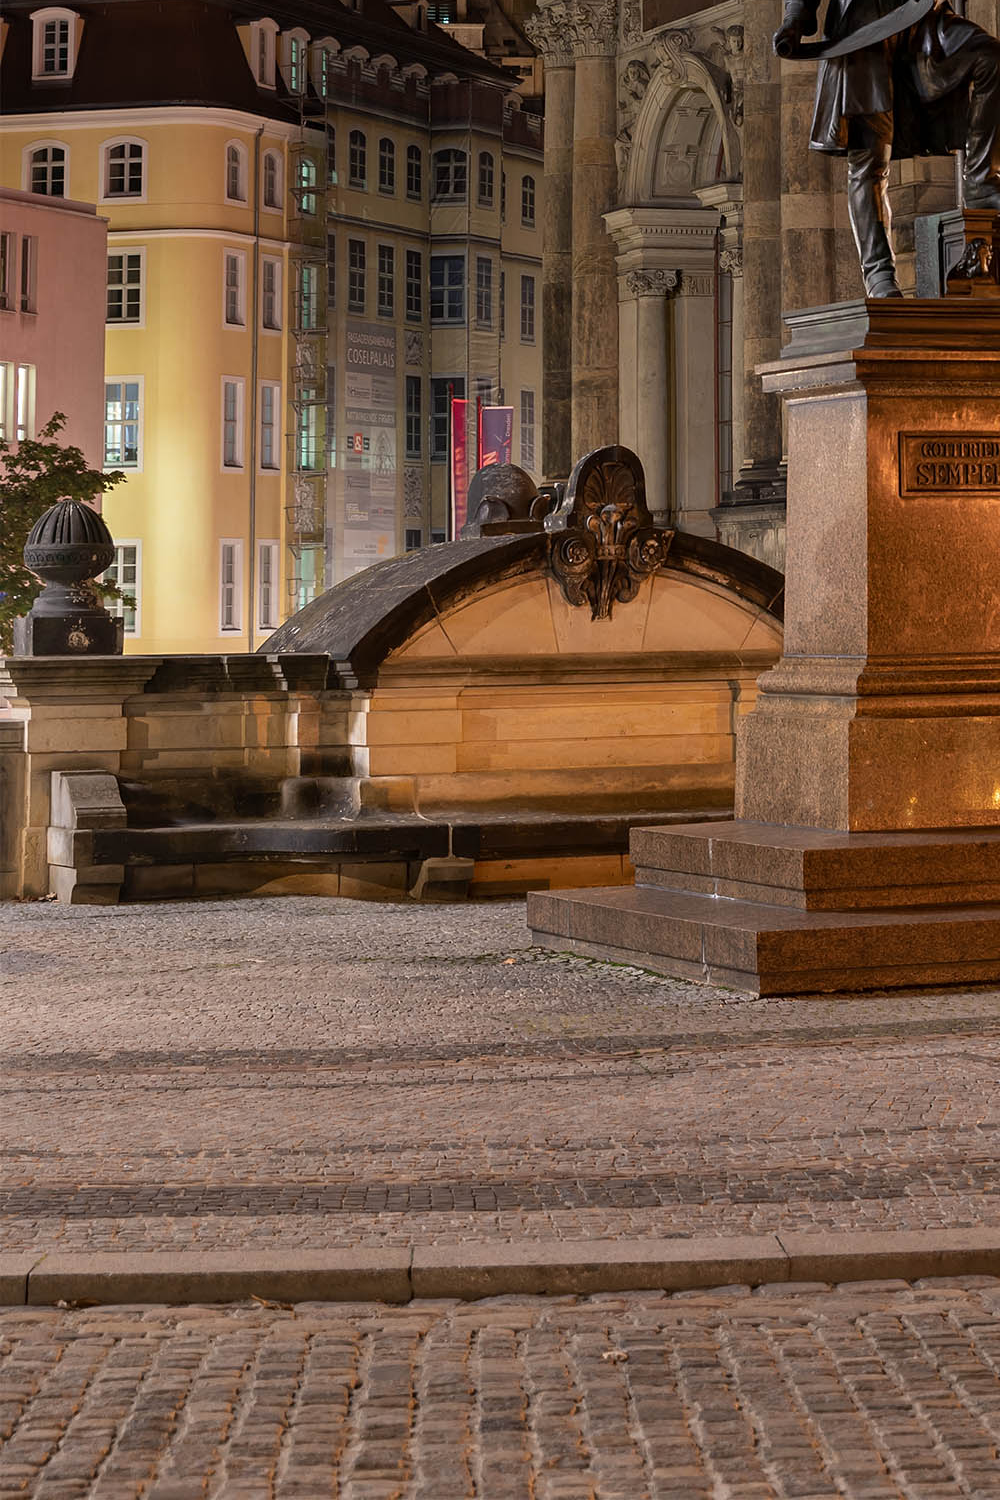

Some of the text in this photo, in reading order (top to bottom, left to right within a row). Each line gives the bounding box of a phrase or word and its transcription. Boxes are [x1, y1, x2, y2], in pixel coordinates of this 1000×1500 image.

[347, 348, 395, 368] COSELPALAIS
[347, 433, 370, 453] S&S
[921, 442, 1000, 458] GOTTFRIED
